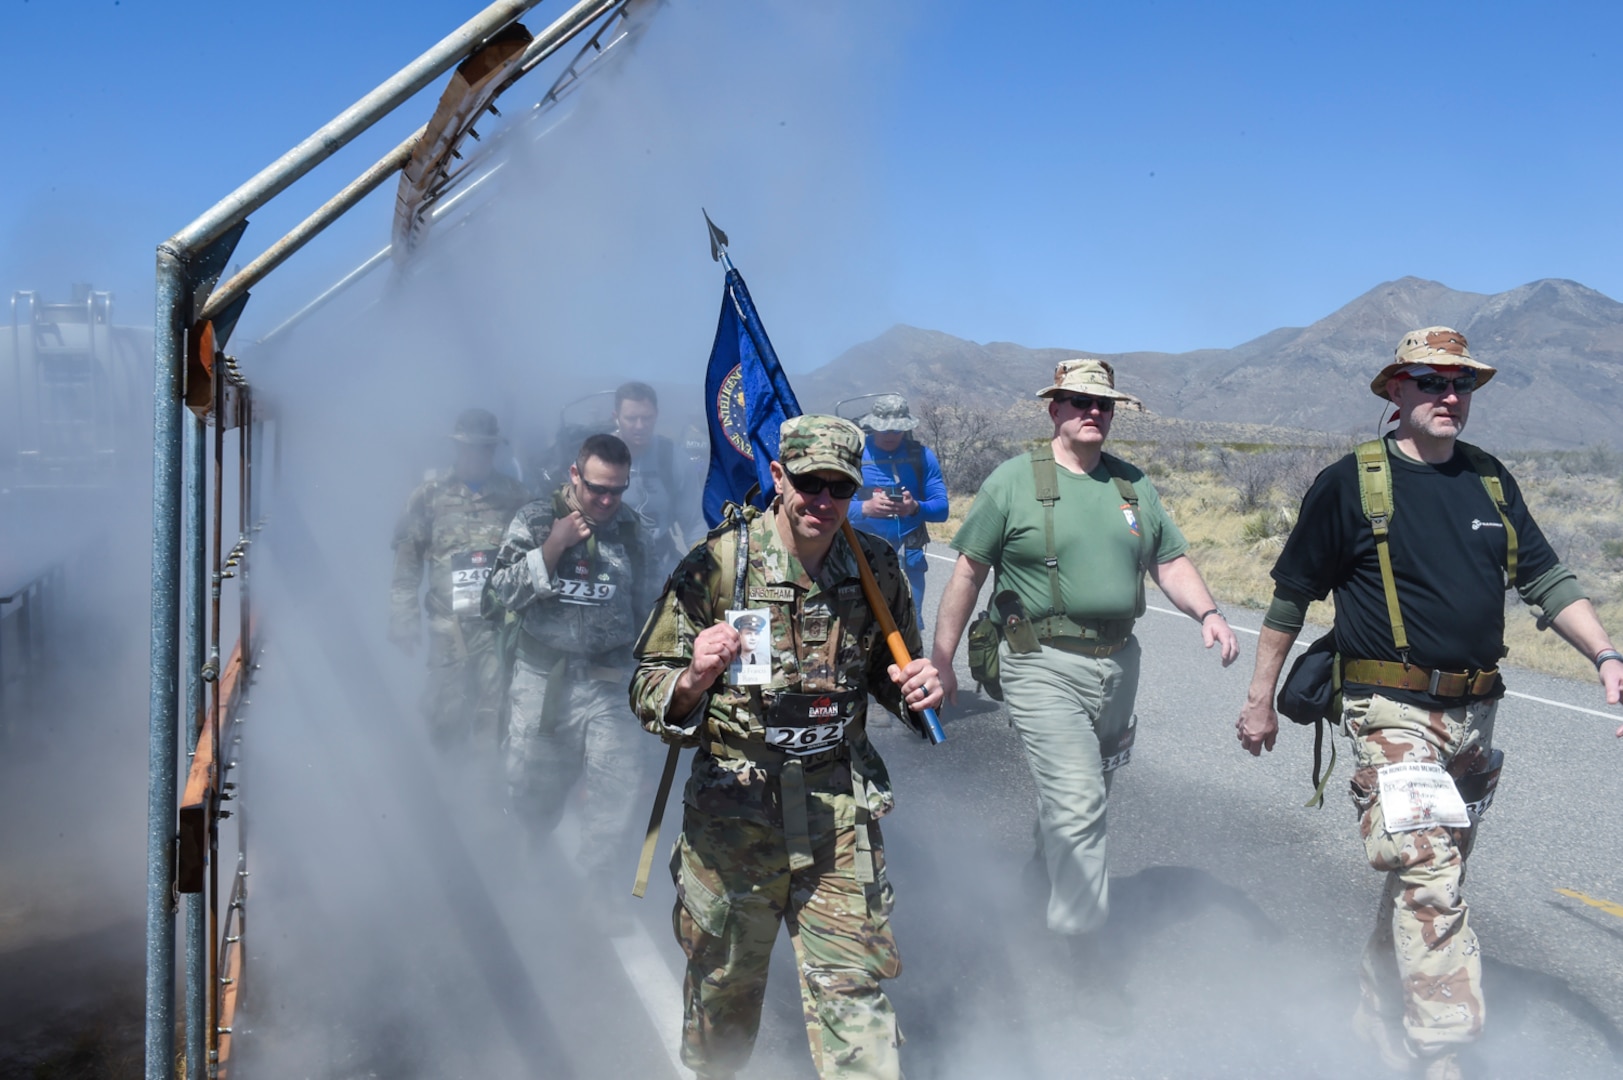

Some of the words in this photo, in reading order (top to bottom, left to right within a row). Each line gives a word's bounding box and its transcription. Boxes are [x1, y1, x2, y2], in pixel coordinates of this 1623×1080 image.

[719, 366, 743, 428] INTELLIGENC
[731, 432, 754, 458] ENSE
[558, 578, 610, 598] 2739
[776, 718, 847, 746] 262
[1409, 764, 1420, 772] AND
